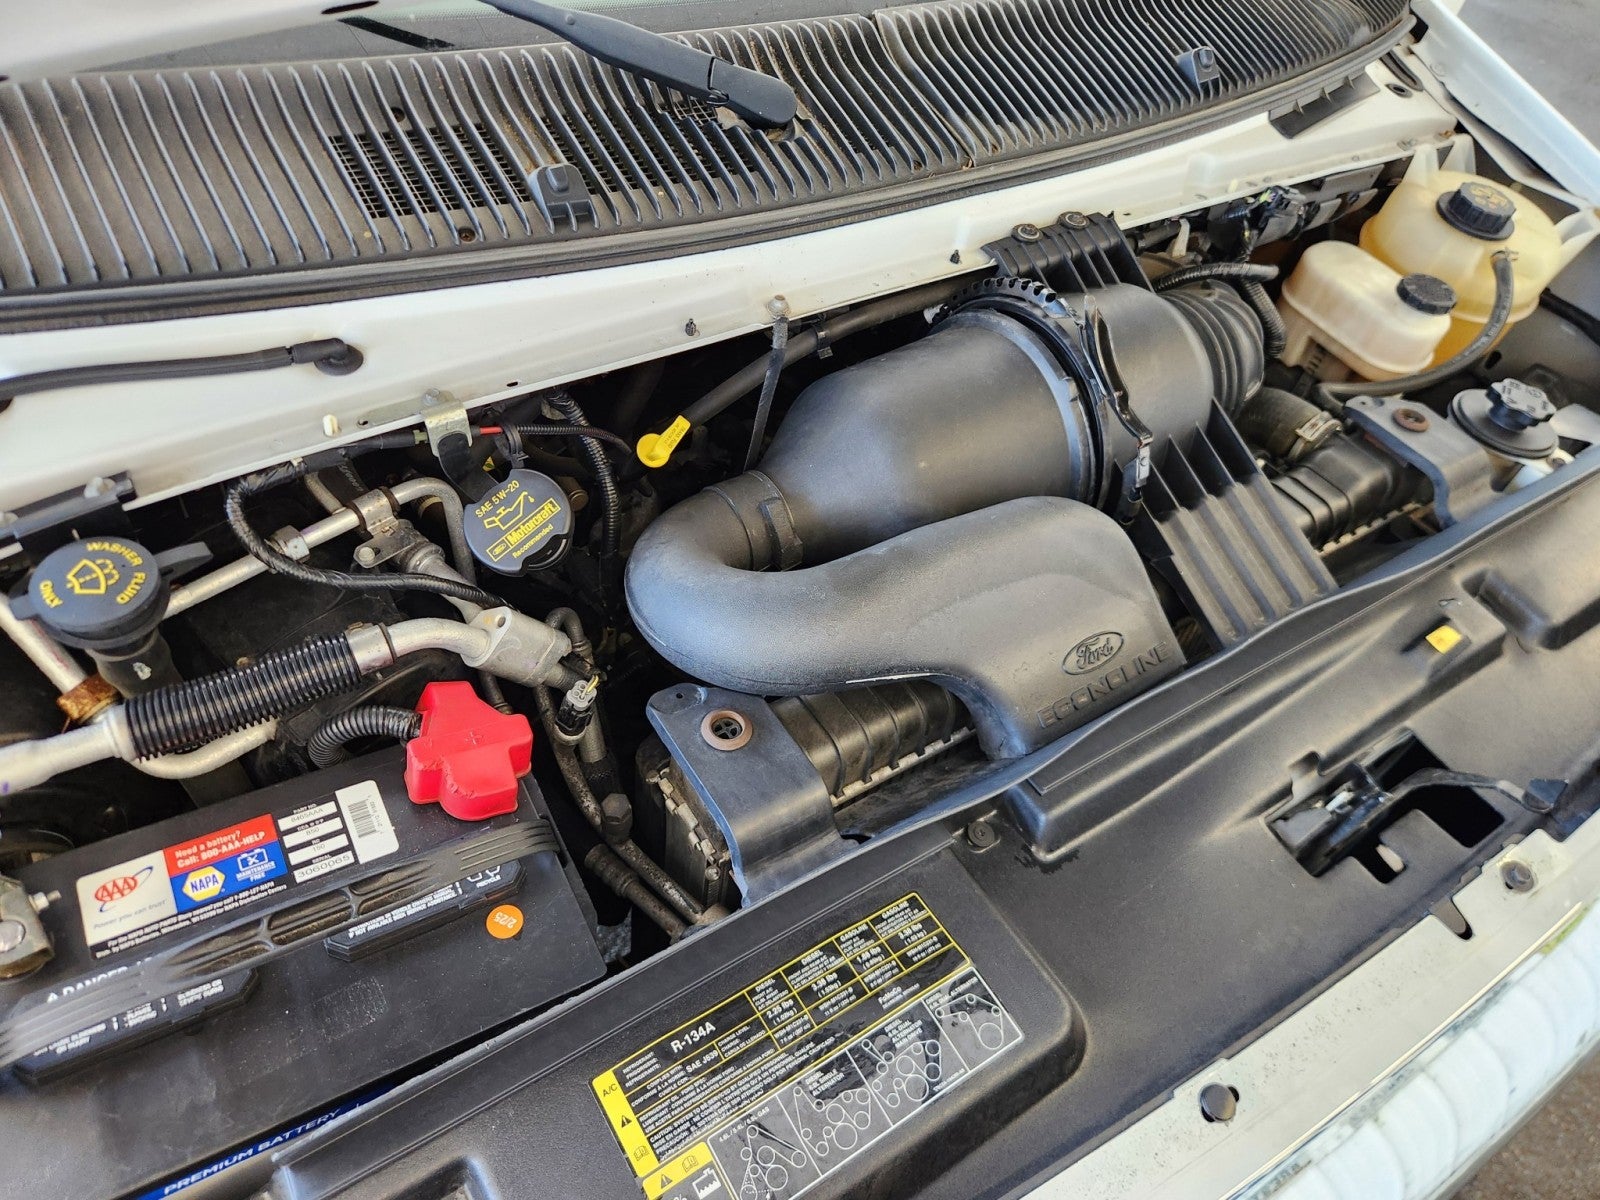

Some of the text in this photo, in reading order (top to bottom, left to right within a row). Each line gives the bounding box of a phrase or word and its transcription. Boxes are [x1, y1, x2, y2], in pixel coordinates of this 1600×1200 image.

[475, 480, 520, 518] SAE 5W-20
[512, 524, 554, 558] Recommended
[39, 541, 146, 608] WASHER FLUID ONLY
[1076, 637, 1115, 669] Ford
[1036, 641, 1168, 728] ECONOLINE
[174, 845, 198, 858] Need
[205, 829, 242, 848] battery?
[176, 830, 267, 868] Call: 800-AAA-HELP
[235, 860, 276, 878] MAINTENANCE
[249, 871, 266, 882] FREE
[98, 875, 135, 903] AAA
[188, 873, 220, 893] NAPA
[881, 899, 909, 920] GASOLINE
[839, 922, 868, 942] GASOLINE
[800, 948, 823, 965] DIESEL
[754, 976, 776, 993] DIESEL
[825, 970, 838, 983] lbs
[949, 975, 978, 997] ALTERNATOR
[877, 984, 902, 1005] FoMoCo
[765, 997, 794, 1018] 2.25 lbs
[883, 1017, 902, 1032] DIESEL
[890, 1019, 923, 1043] ALTERNATOR
[897, 1018, 912, 1031] DUAL
[669, 1018, 717, 1054] R-134A
[894, 1026, 923, 1048] MAIN DRIVE
[685, 1048, 719, 1073] SAE J639
[805, 1069, 824, 1084] DIESEL
[811, 1071, 845, 1096] ALTERNATOR
[818, 1068, 838, 1084] SINGLE
[601, 1082, 618, 1096] A/C
[696, 1110, 718, 1127] SISTEMA
[730, 1096, 741, 1106] SER
[739, 1081, 764, 1099] ATENDIDO
[775, 1066, 787, 1076] POR
[649, 1124, 674, 1143] CAUTION:
[672, 1111, 694, 1128] SYSTEM
[692, 1106, 701, 1115] TO
[699, 1102, 708, 1110] BE
[706, 1087, 731, 1106] SERVICED
[729, 1082, 738, 1091] BY
[736, 1067, 762, 1086] QUALIFIED
[652, 1137, 666, 1149] MISE
[664, 1132, 674, 1140] EN
[672, 1120, 691, 1136] GARDE
[692, 1114, 701, 1123] NE
[699, 1101, 722, 1118] CONFIER
[760, 1070, 769, 1078] UN
[756, 1105, 770, 1117] GAS
[161, 1107, 343, 1195] PREMIUM BATTERY
